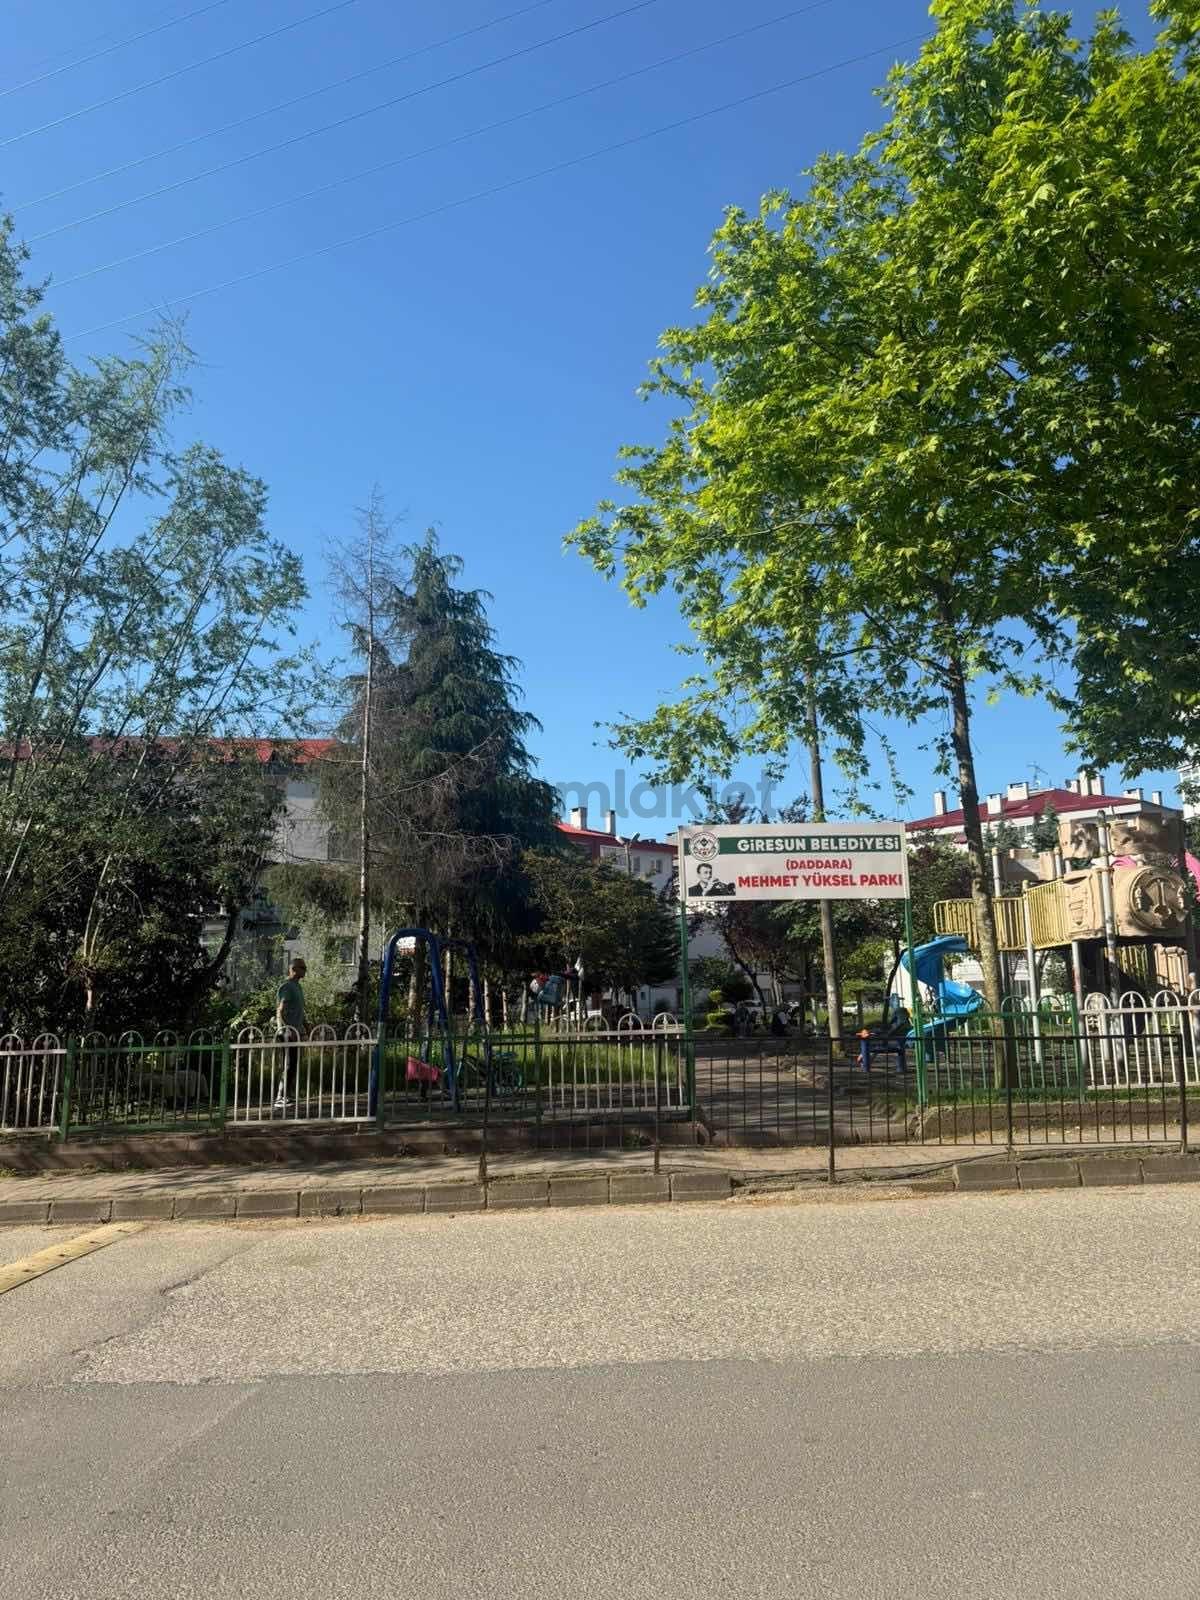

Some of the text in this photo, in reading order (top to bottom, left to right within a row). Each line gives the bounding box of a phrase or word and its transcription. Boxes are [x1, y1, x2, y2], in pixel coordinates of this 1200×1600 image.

[786, 858, 852, 870] (DADDARA)
[738, 871, 903, 888] MEHMET YÜKSEL PARKI
